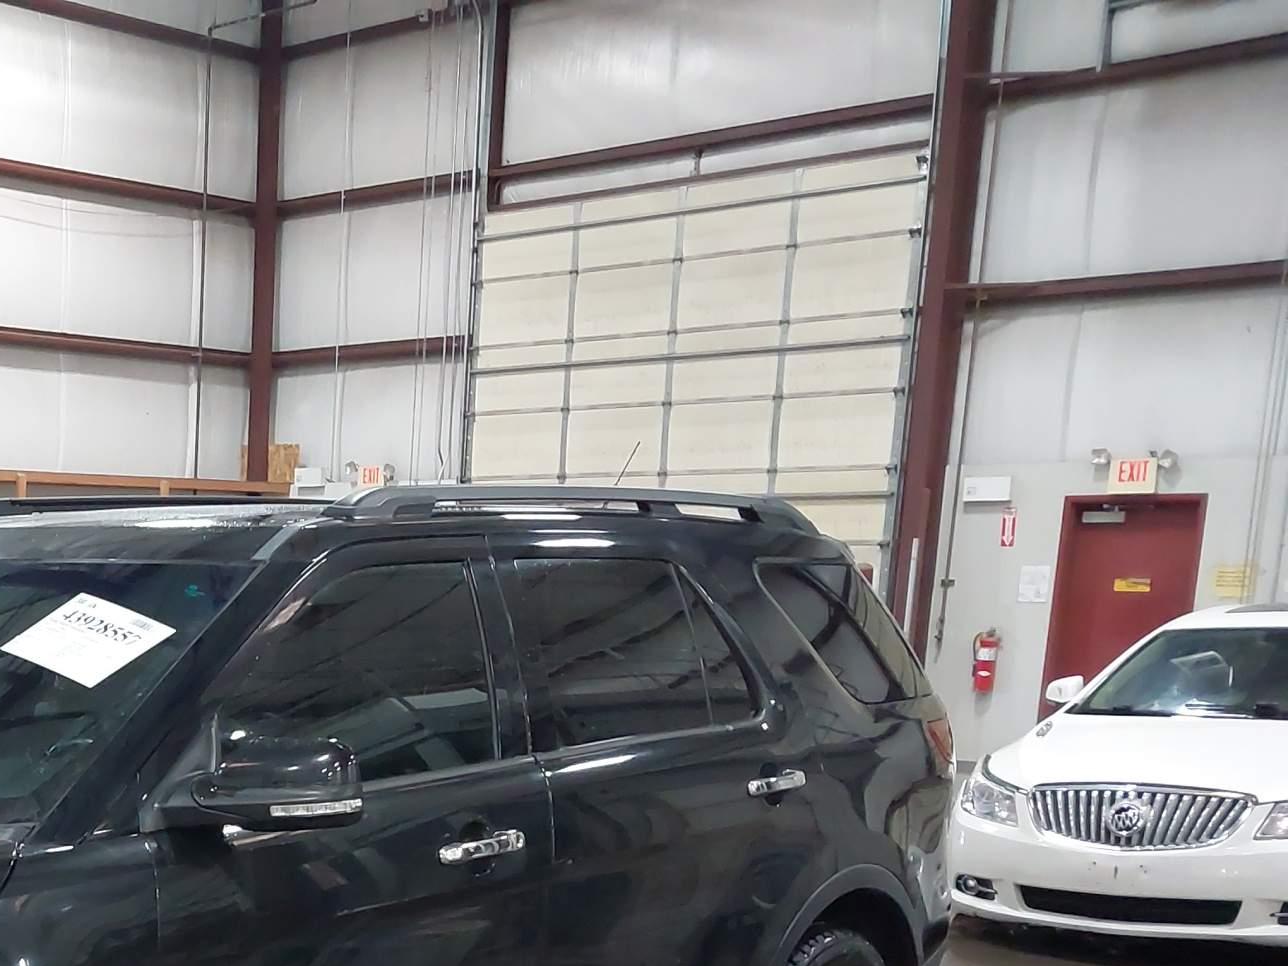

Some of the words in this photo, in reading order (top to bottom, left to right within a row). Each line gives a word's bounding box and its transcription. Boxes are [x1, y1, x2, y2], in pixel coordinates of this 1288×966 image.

[363, 467, 379, 484] EXIT
[1118, 460, 1150, 482] EXIT
[63, 610, 142, 645] 43928557
